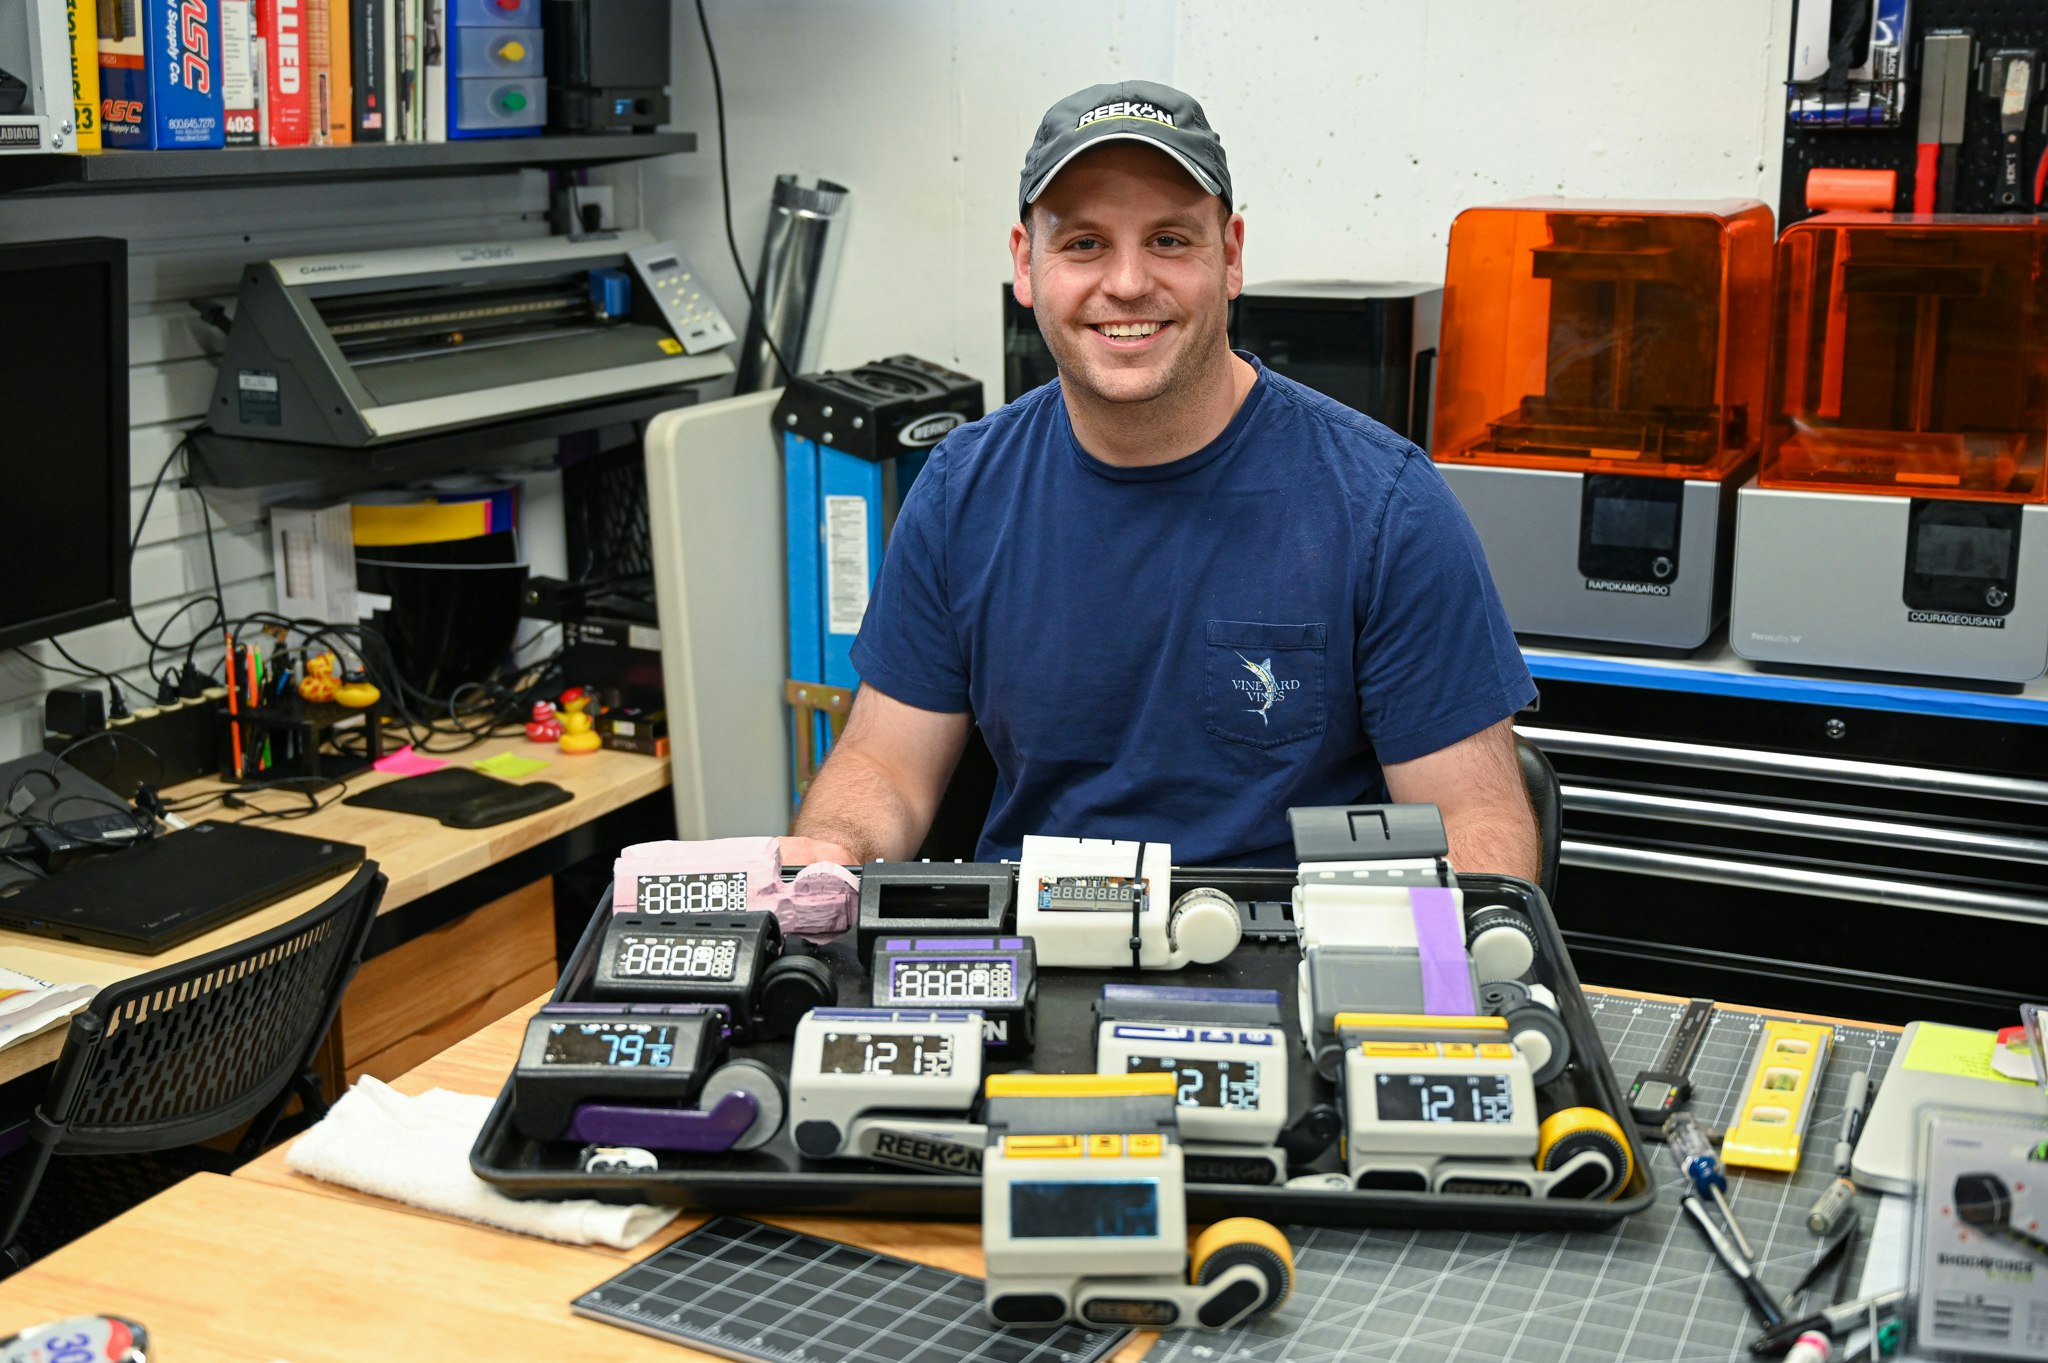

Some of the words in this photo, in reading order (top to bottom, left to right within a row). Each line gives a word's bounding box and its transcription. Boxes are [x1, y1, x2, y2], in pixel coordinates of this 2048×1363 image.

[166, 8, 179, 60] Supply
[108, 123, 129, 134] Supply
[226, 116, 254, 133] 403
[0, 127, 38, 140] ADIATOR
[1911, 612, 2003, 627] COURAGEOUSANT
[1232, 679, 1300, 691] VINEARD
[601, 1034, 644, 1066] 79
[877, 1132, 983, 1171] REEKON
[1185, 1160, 1270, 1178] EEKON
